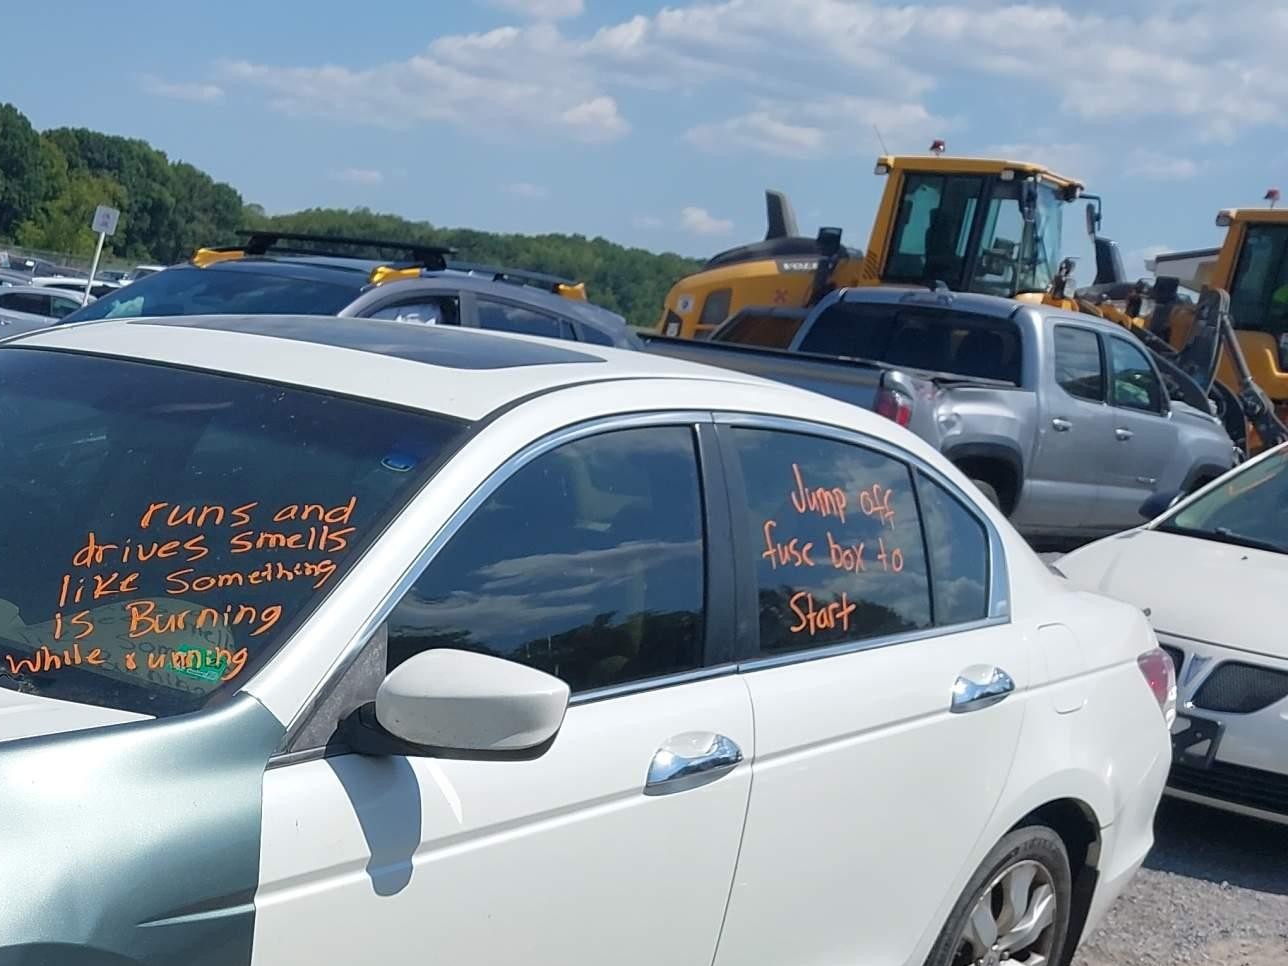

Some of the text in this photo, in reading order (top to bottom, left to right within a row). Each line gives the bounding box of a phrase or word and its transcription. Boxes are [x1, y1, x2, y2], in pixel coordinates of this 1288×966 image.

[140, 496, 357, 529] runs and
[791, 463, 895, 530] Jump off
[72, 525, 357, 568] drives smells
[827, 531, 865, 576] box
[877, 536, 904, 572] to
[127, 601, 282, 638] Burning
[789, 591, 856, 636] Start
